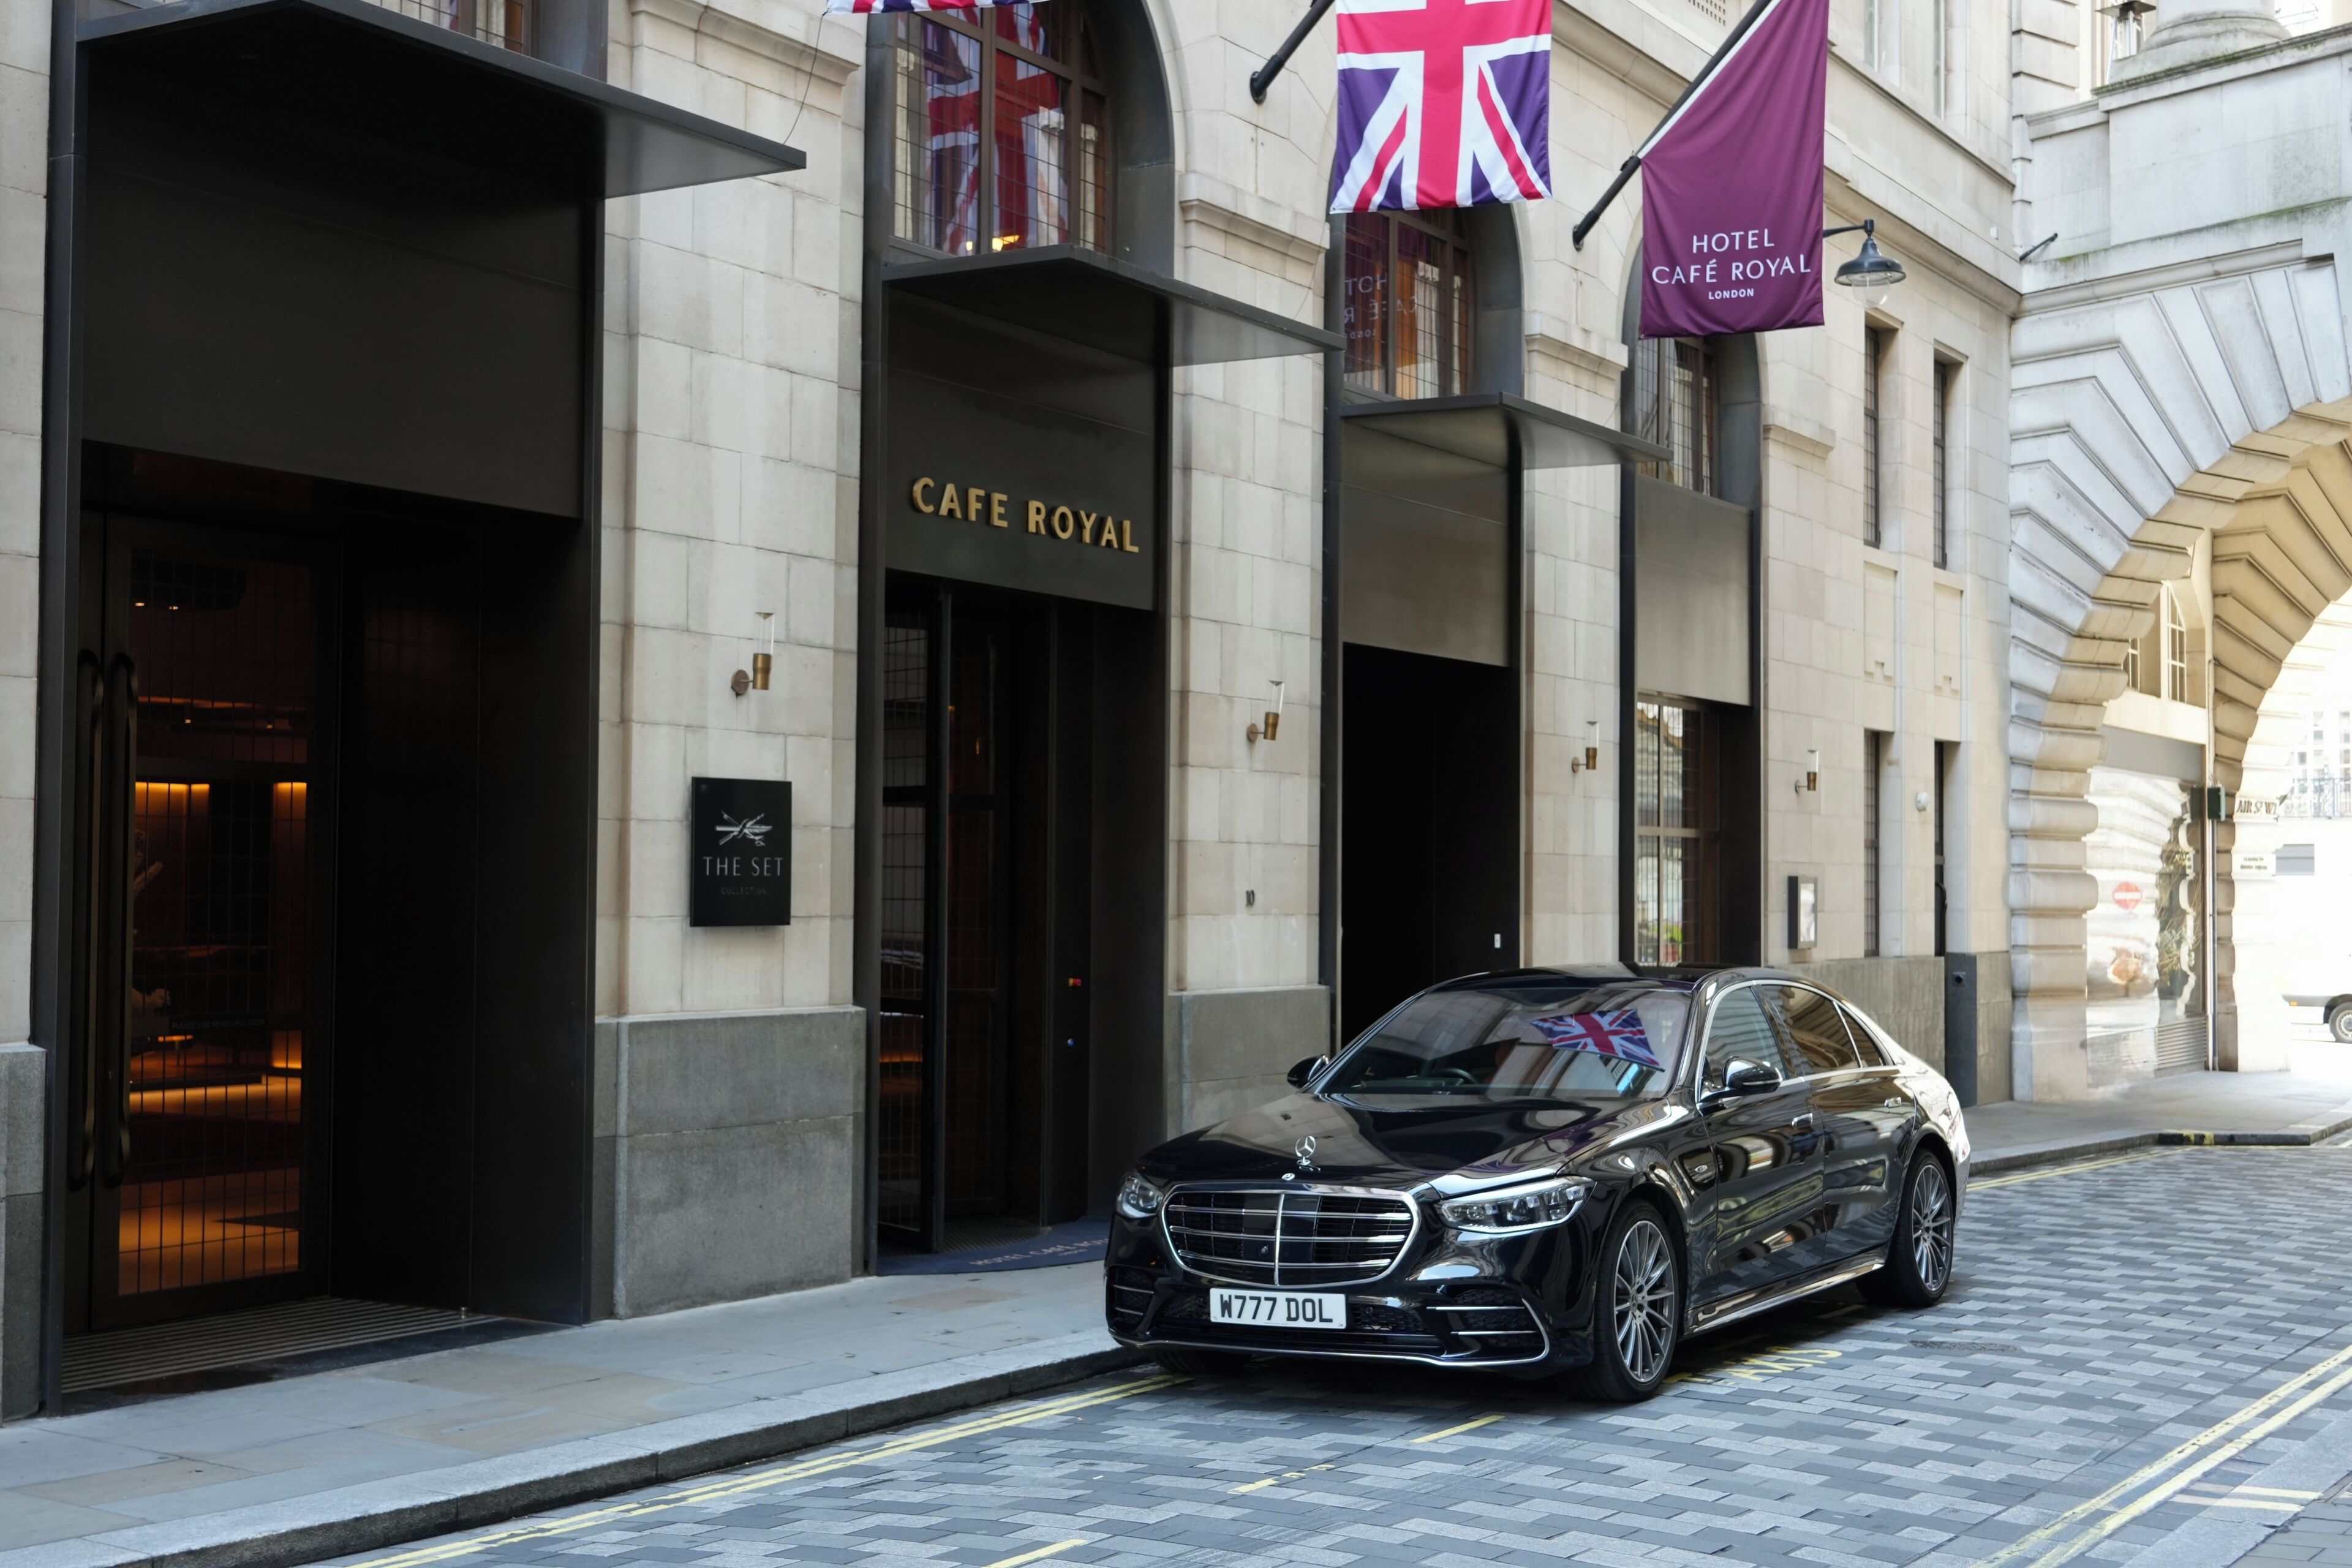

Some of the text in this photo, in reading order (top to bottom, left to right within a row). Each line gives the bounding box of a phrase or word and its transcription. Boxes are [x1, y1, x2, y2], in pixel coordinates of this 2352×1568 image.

[1692, 228, 1775, 254] HOTEL
[1652, 254, 1811, 285] CAFÉ ROYAL
[1708, 288, 1754, 300] LONDON
[913, 477, 1139, 553] CAFE ROYAL
[2236, 800, 2252, 813] AIR
[2265, 801, 2277, 815] W1
[703, 856, 784, 876] THE SET
[721, 886, 768, 895] COLLECTION
[1245, 889, 1256, 907] 10
[1219, 1294, 1333, 1323] W777 DOL
